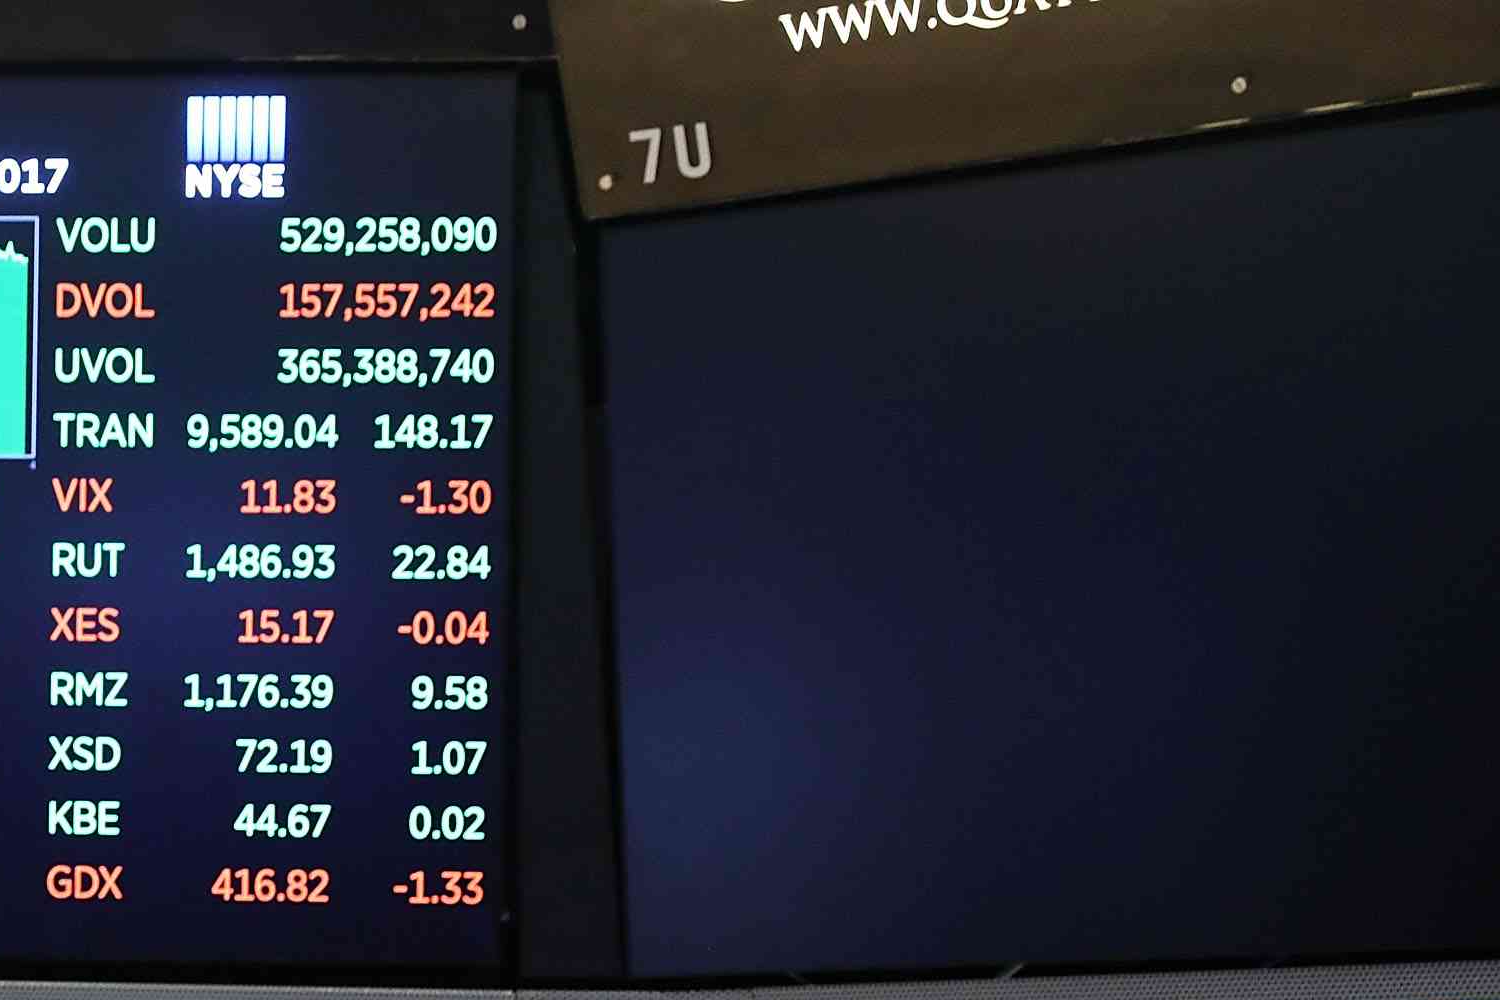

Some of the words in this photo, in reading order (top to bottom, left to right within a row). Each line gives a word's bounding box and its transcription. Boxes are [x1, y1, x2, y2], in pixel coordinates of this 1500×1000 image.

[185, 163, 286, 199] NYSE
[56, 217, 155, 253] VOLU
[280, 217, 497, 256] 529,258,090
[56, 283, 155, 318] DVOL
[280, 283, 494, 321] 157,557,242
[55, 348, 155, 383] UVOL
[277, 348, 494, 387] 365,388,740
[53, 413, 153, 448] TRAN
[187, 414, 339, 453] 9,589.04
[374, 414, 493, 449] 148.17
[52, 478, 112, 512] VIX
[241, 480, 335, 513] 11.83
[400, 480, 491, 514] -1.30
[52, 542, 125, 577] RUT
[186, 544, 335, 582] 1,486.93
[392, 545, 491, 579] 22.84
[50, 608, 119, 642] XES
[238, 609, 334, 643] 15.17
[398, 611, 489, 644] -0.04
[51, 672, 128, 706] RMZ
[184, 674, 333, 711] 1,176.39
[412, 676, 487, 710] 9.58
[48, 736, 121, 771] XSD
[236, 739, 332, 773] 72.19
[411, 741, 487, 775] 1.07
[49, 800, 120, 835] KBE
[234, 804, 331, 838] 44.67
[409, 806, 484, 840] 0.02
[47, 865, 122, 899] GDX
[212, 869, 329, 902] 416.82
[393, 871, 483, 904] -1.33
